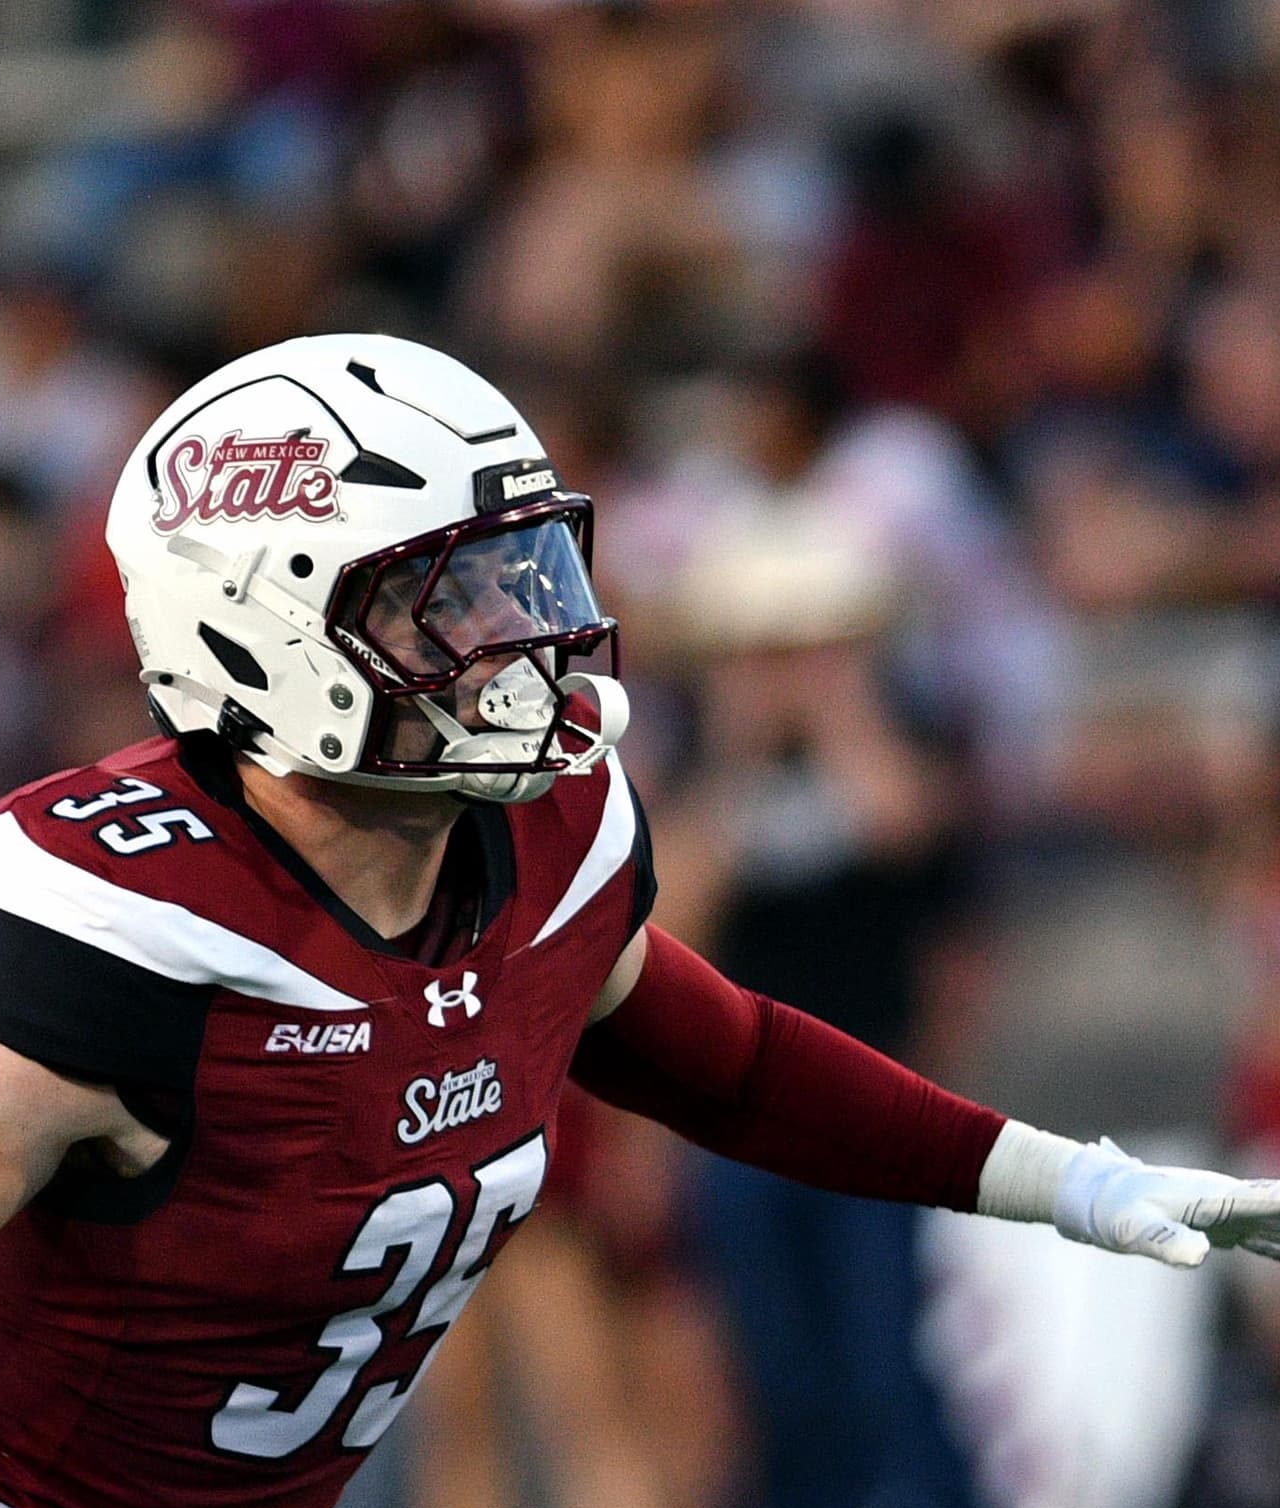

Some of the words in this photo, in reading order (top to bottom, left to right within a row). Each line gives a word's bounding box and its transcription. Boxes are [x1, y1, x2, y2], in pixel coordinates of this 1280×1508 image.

[152, 427, 338, 533] State
[213, 446, 248, 462] NEW
[252, 445, 319, 460] MEXICO
[51, 777, 215, 854] 35
[397, 1059, 502, 1144] State
[210, 1131, 547, 1459] 35
